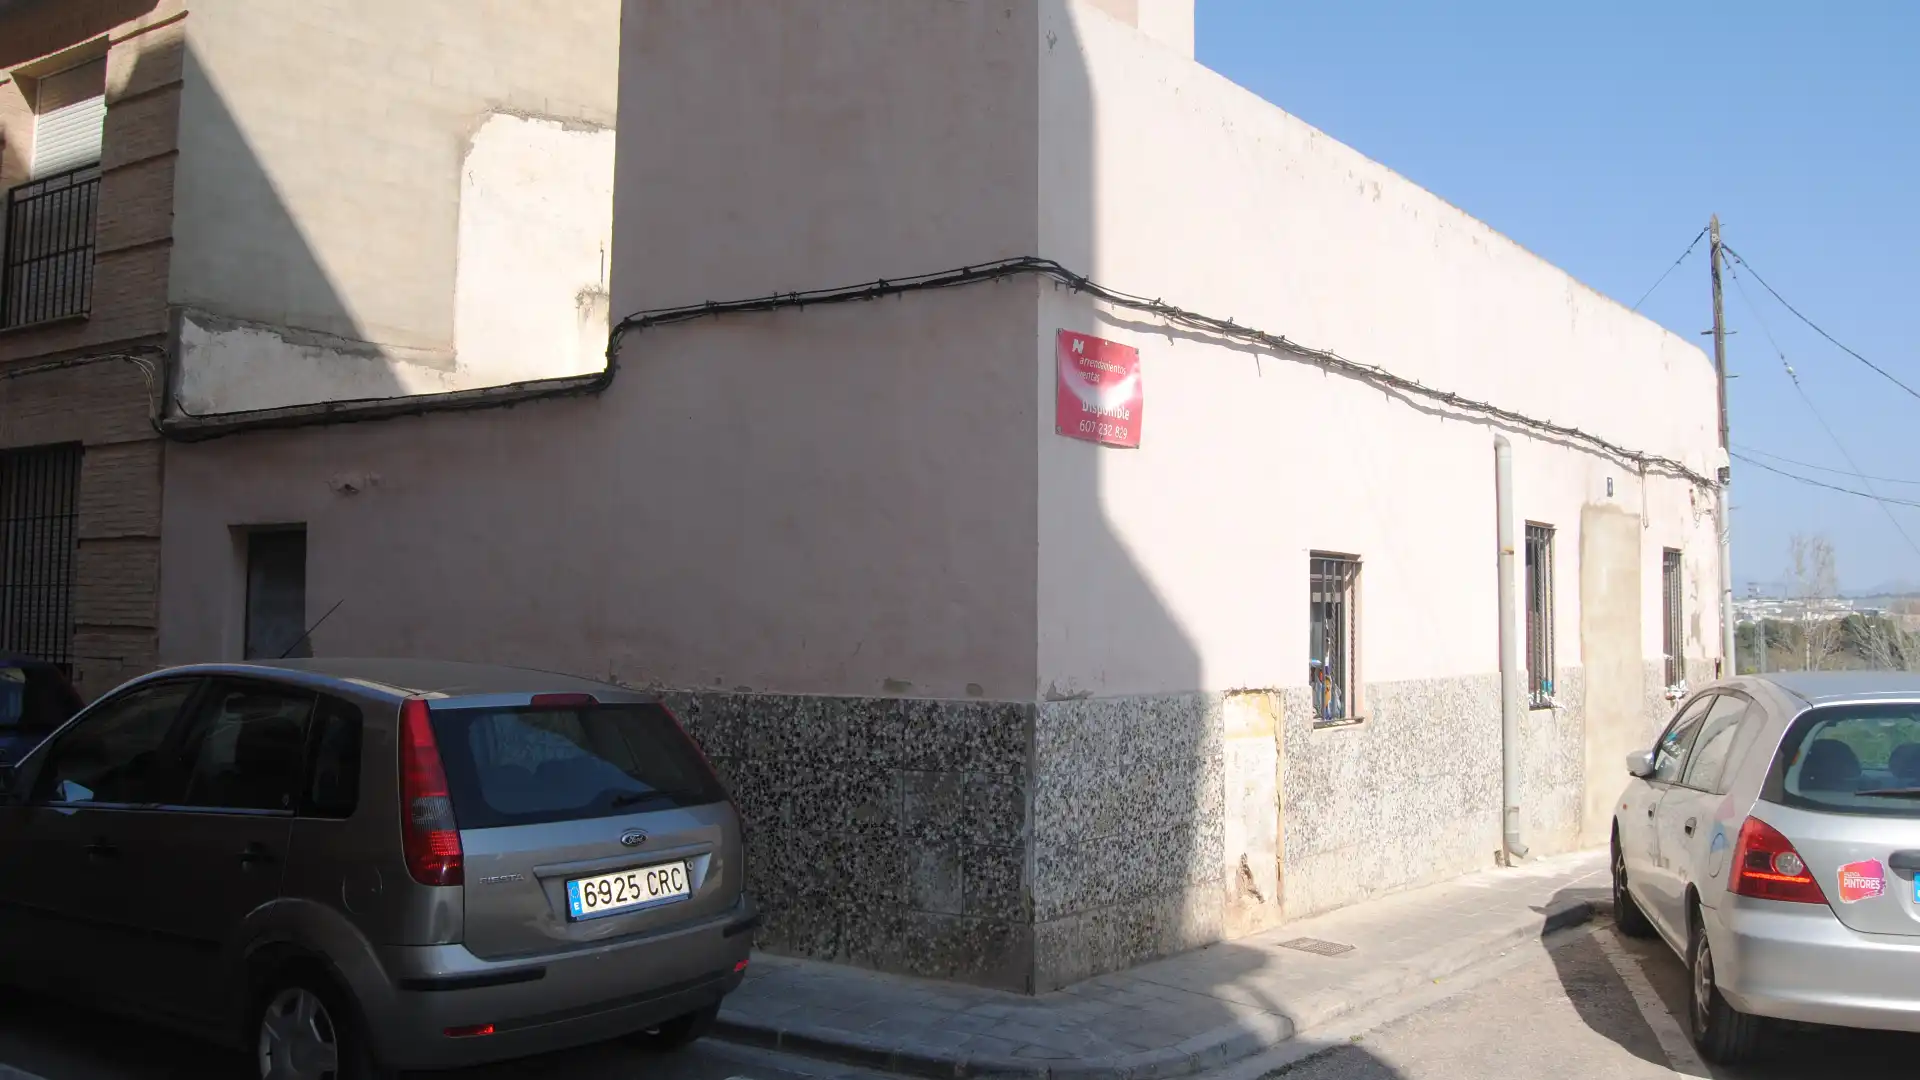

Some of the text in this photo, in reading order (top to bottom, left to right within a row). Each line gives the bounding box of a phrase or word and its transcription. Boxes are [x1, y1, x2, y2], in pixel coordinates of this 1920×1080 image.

[1082, 400, 1130, 420] Disponible
[1079, 419, 1096, 433] 607
[1098, 423, 1113, 437] 232
[627, 833, 643, 845] Ford
[479, 873, 524, 884] FIESTA
[1843, 879, 1880, 890] PINTORES
[584, 867, 683, 907] 6925 CRC
[573, 902, 580, 911] E
